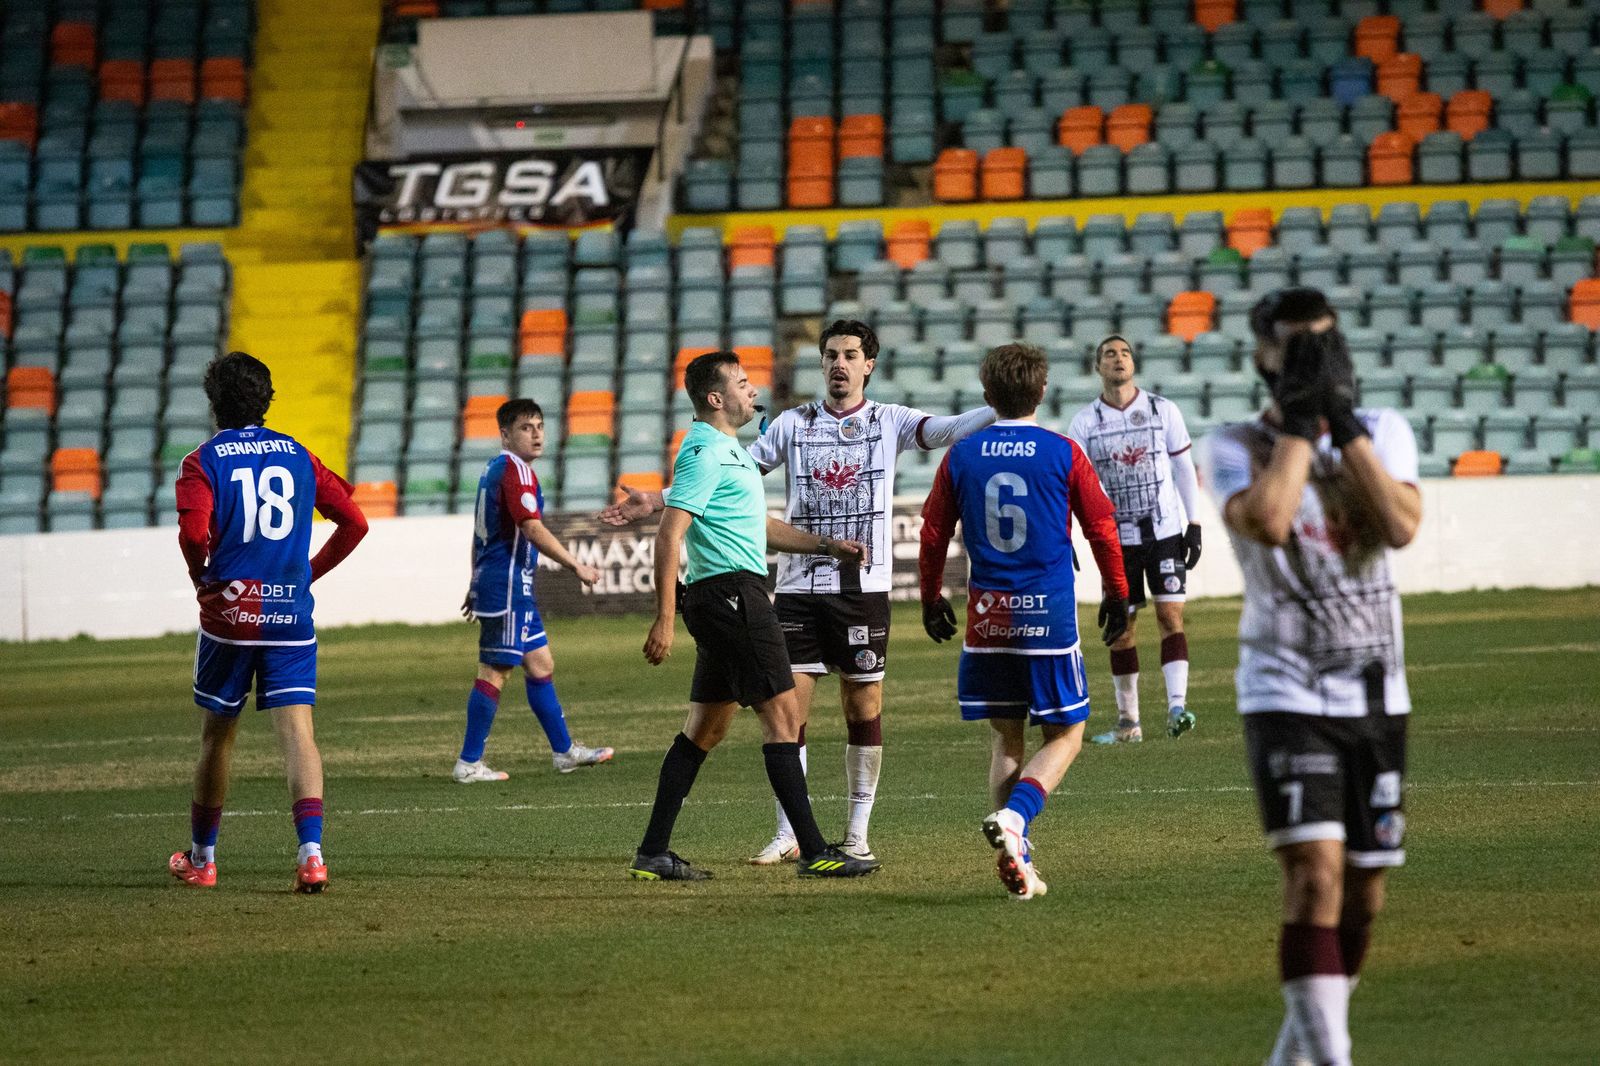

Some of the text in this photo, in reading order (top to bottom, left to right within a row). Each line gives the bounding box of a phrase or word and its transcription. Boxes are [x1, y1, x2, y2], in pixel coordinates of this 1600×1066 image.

[388, 160, 610, 207] TGSA
[214, 439, 297, 458] BENAVENTE
[981, 441, 1037, 457] LUCAS
[230, 465, 295, 543] 18
[984, 471, 1028, 553] 6
[247, 583, 297, 598] ADBT
[997, 594, 1048, 609] ADBT
